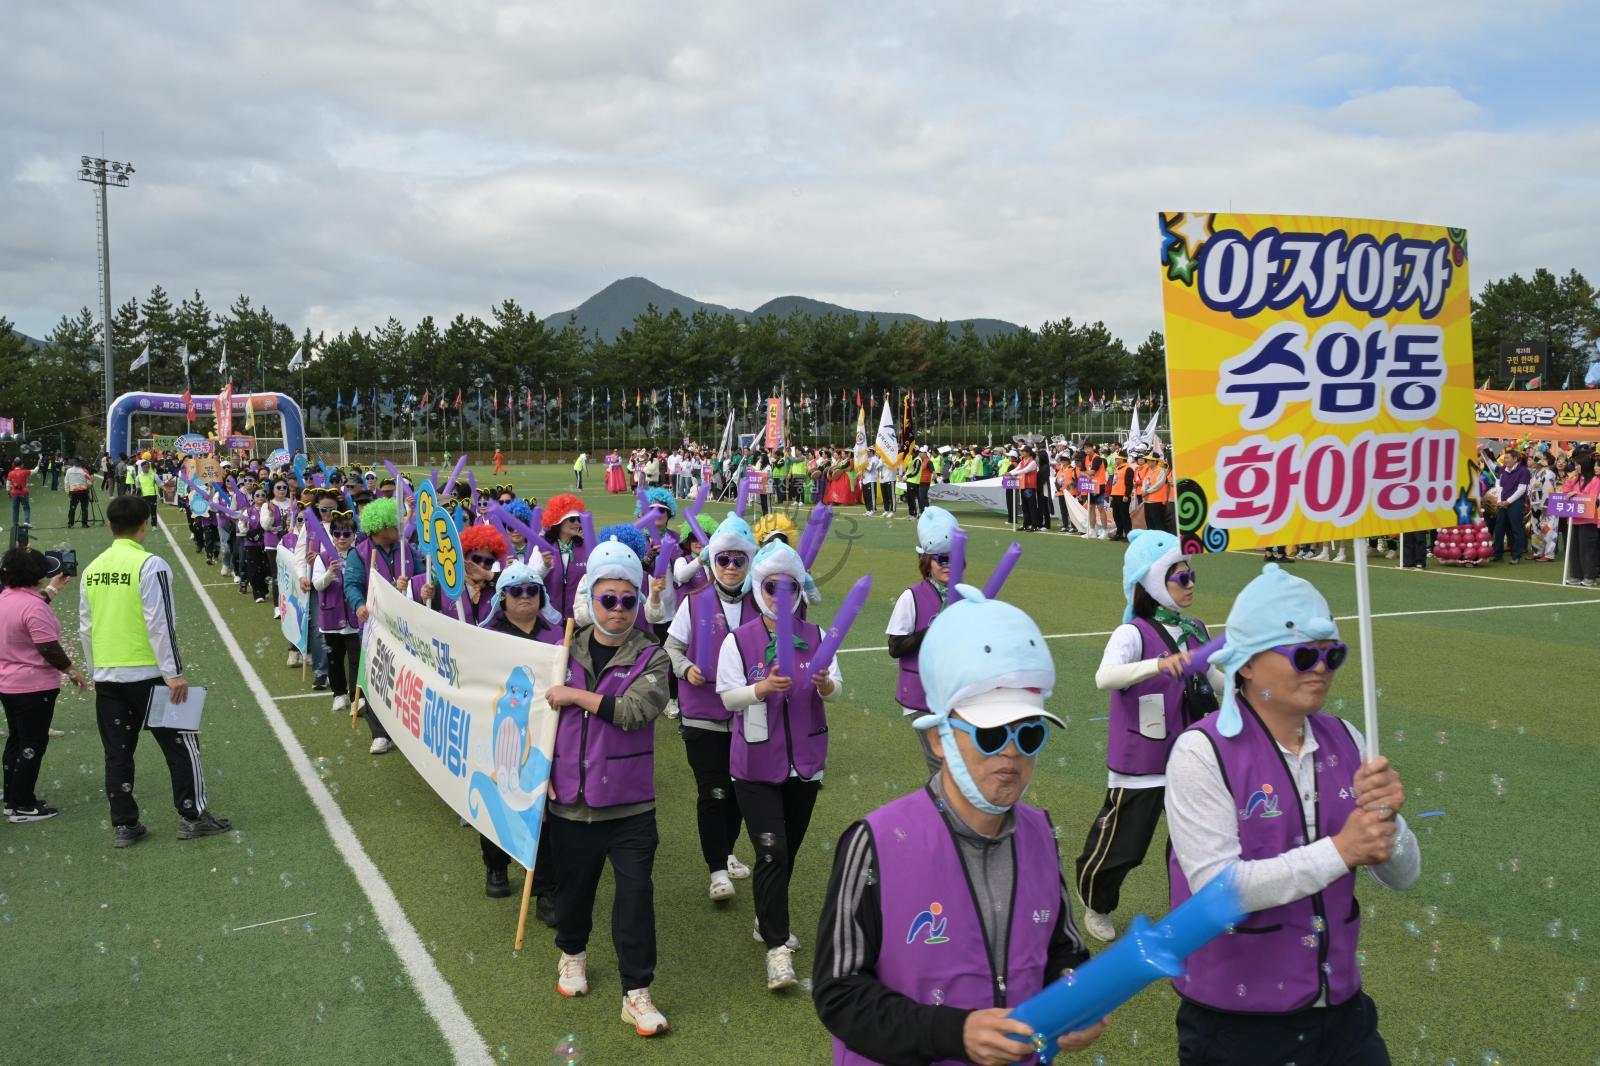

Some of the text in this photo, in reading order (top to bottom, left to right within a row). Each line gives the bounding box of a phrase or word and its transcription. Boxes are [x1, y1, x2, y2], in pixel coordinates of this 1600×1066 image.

[1200, 229, 1451, 318] 아자아자
[1222, 328, 1445, 422] 수암동
[1474, 402, 1505, 423] 산의
[1215, 435, 1457, 525] 화이팅!!
[1556, 502, 1585, 514] 무거동
[420, 490, 433, 543] 암
[86, 572, 131, 586] 남구체육회
[434, 518, 457, 588] 동
[394, 664, 424, 740] 수암동
[422, 687, 472, 778] 파이팅!
